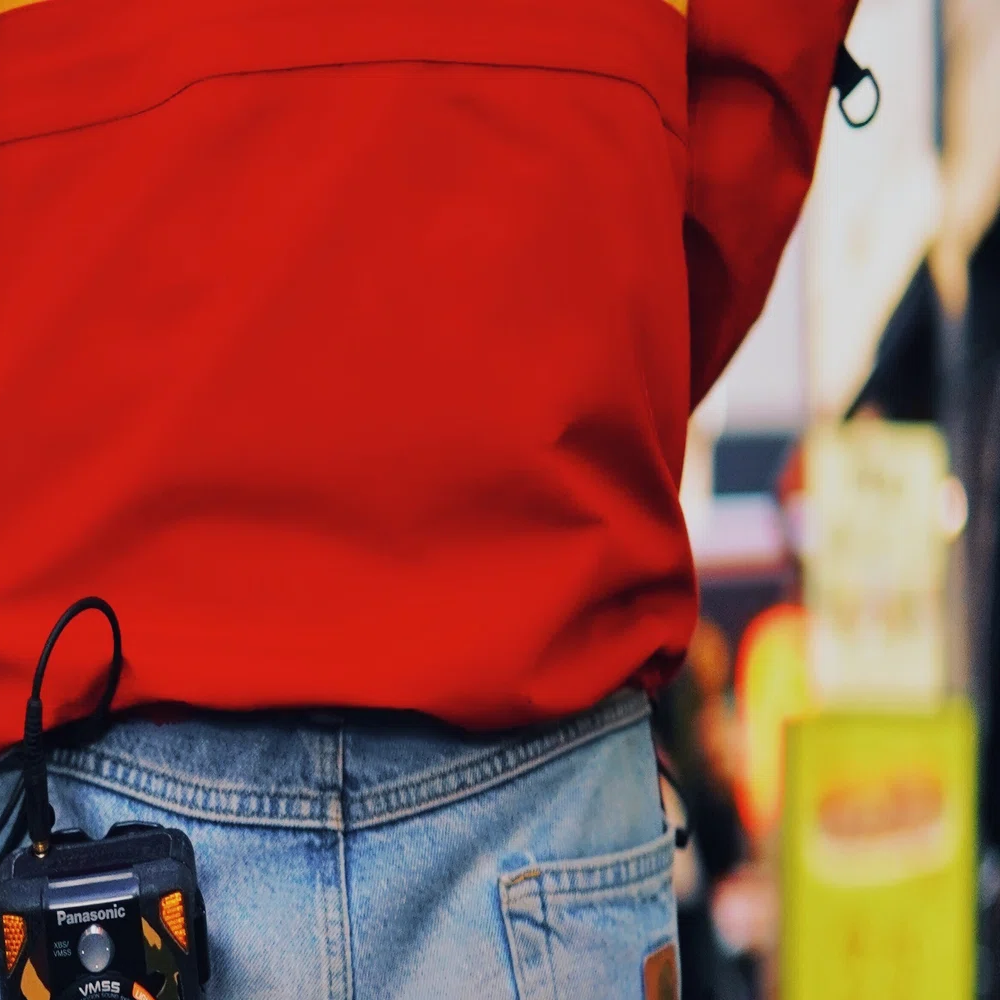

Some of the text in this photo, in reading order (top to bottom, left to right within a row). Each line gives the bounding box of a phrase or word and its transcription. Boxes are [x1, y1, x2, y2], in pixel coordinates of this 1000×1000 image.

[56, 903, 126, 926] Panasonic
[53, 948, 72, 957] VMSS
[79, 980, 121, 997] VMSS
